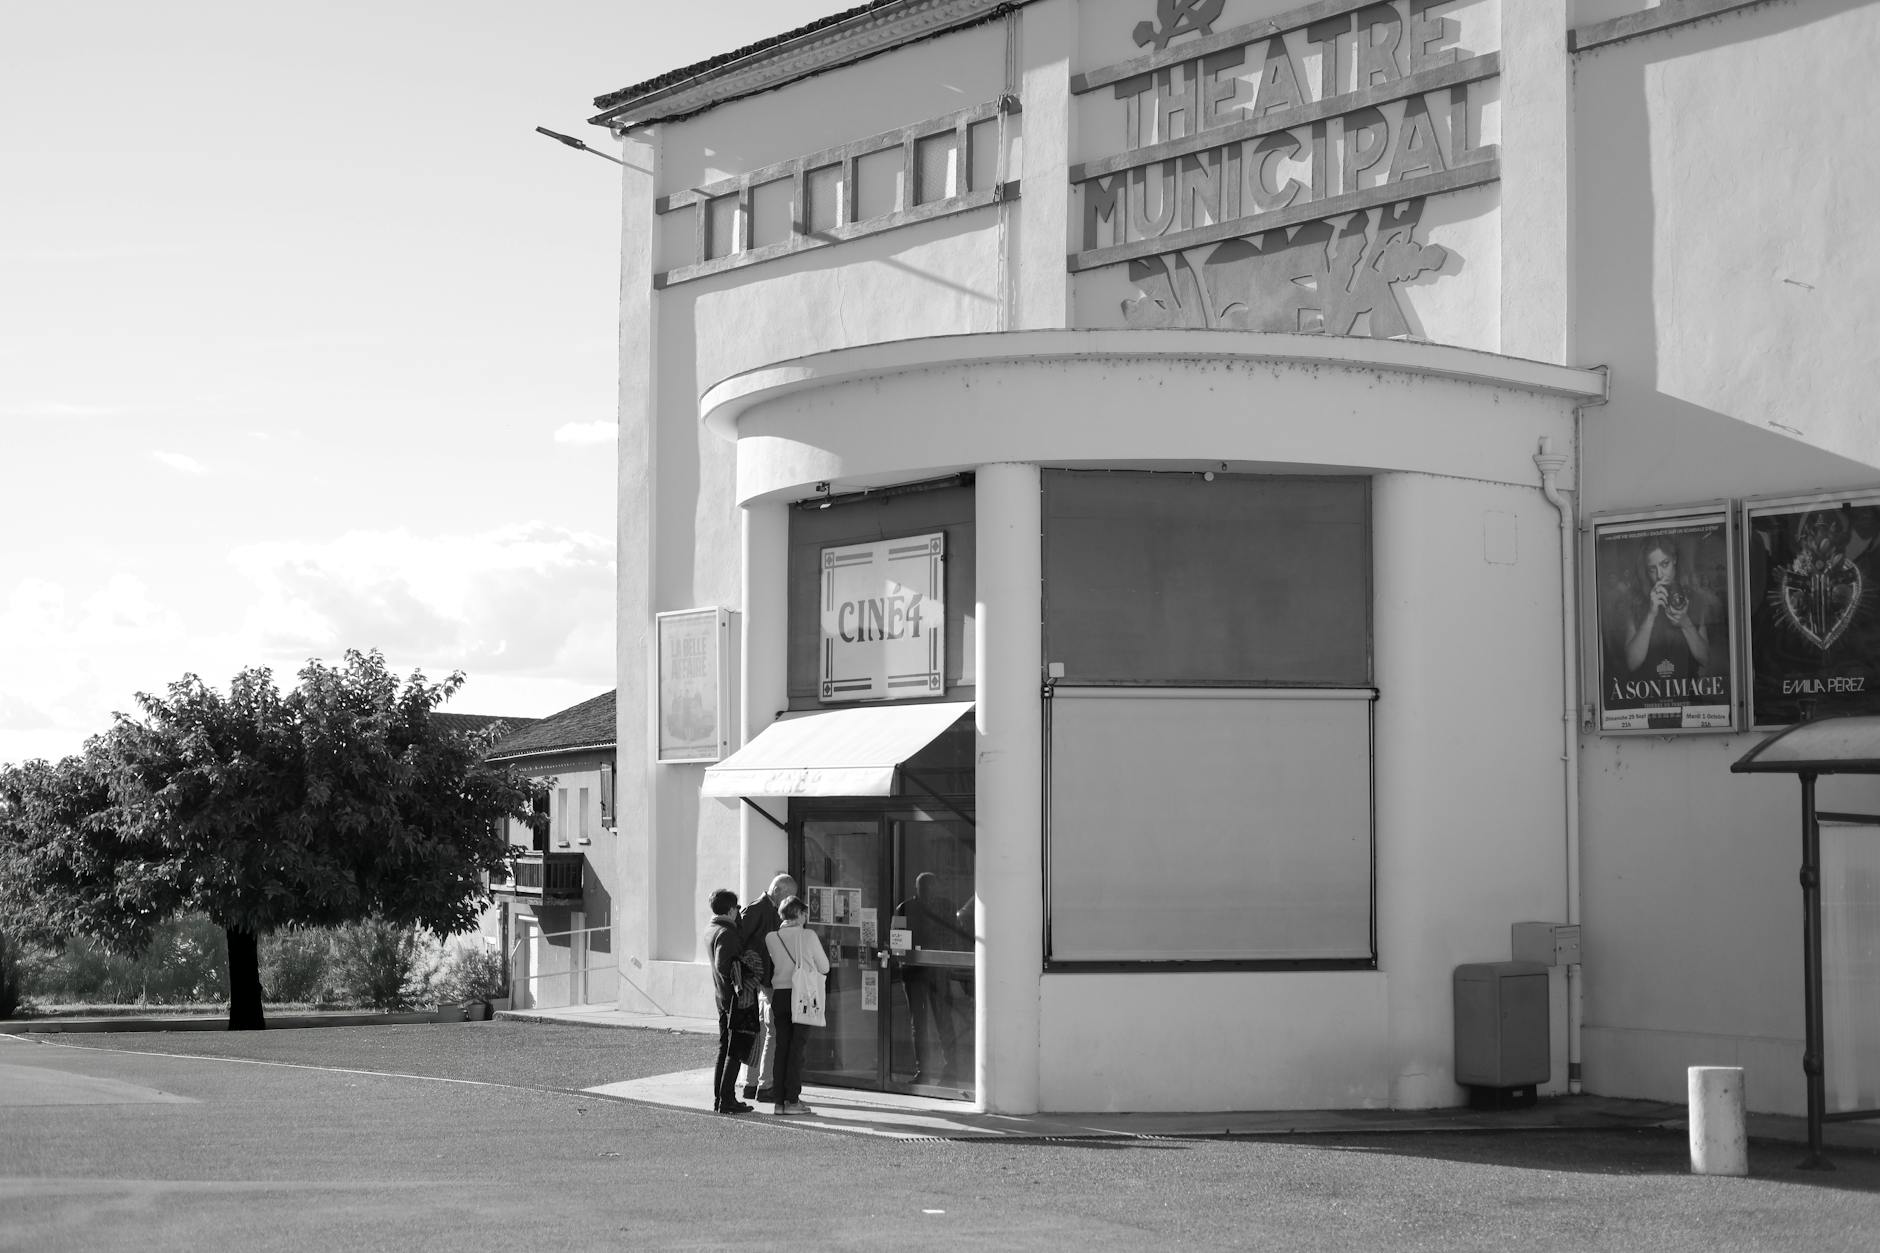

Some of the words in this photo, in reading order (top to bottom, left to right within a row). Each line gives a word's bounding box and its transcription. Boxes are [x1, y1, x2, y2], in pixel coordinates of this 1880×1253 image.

[1114, 0, 1457, 151] THEATRE
[1083, 84, 1499, 251] MUNICIPAL
[1611, 677, 1623, 700] À
[1626, 679, 1661, 699] SON
[1666, 676, 1724, 697] IMAGE
[1783, 679, 1825, 694] EMILIA
